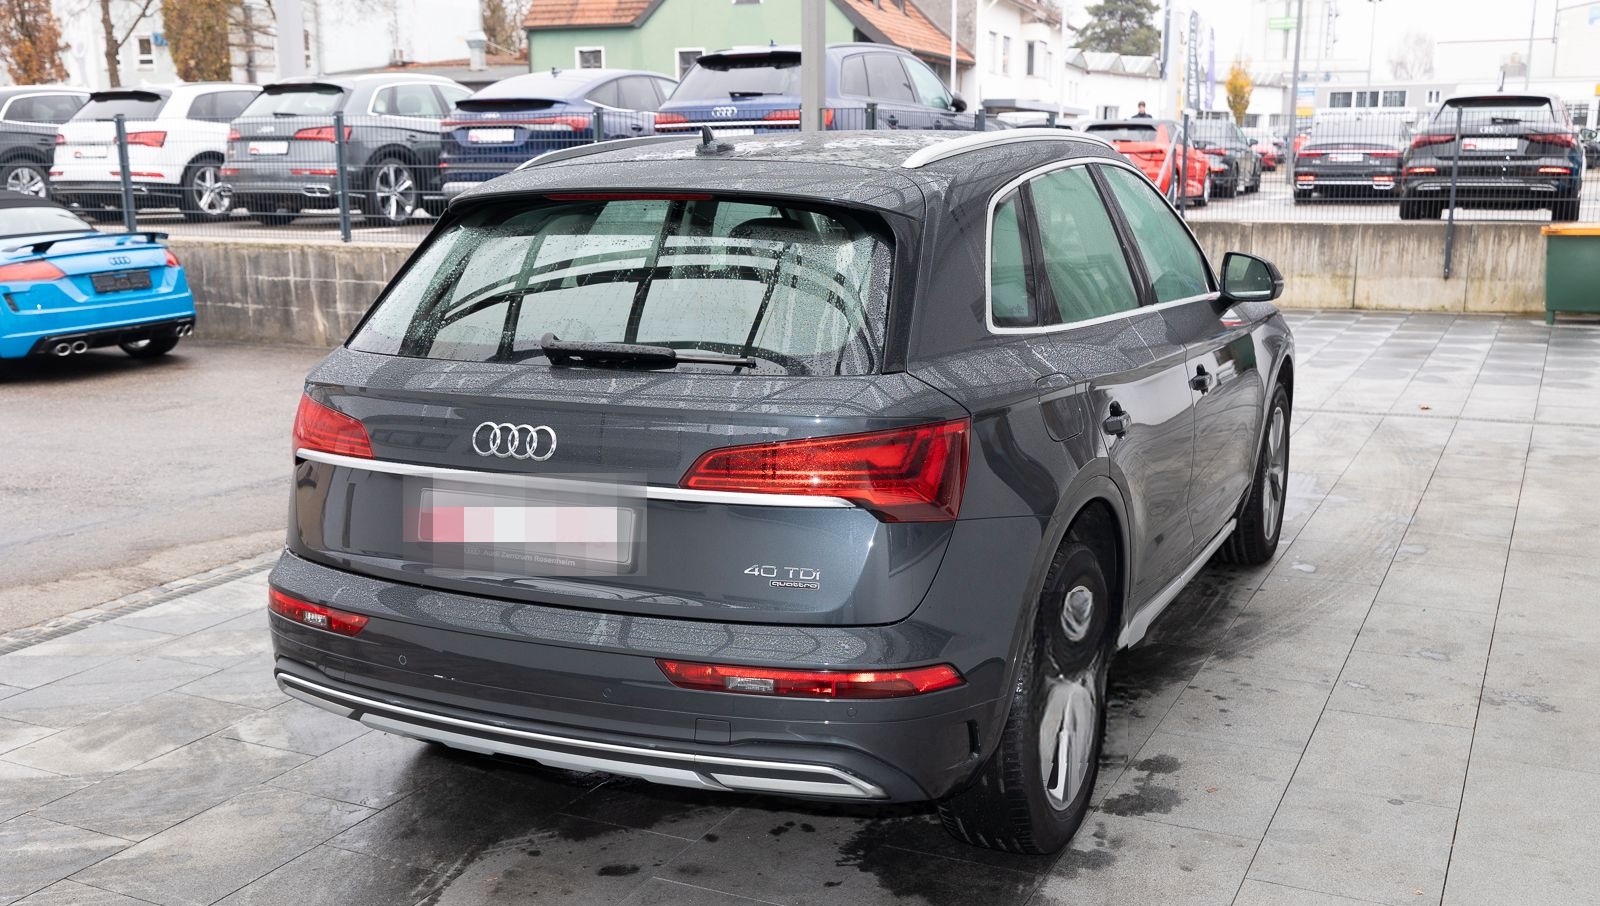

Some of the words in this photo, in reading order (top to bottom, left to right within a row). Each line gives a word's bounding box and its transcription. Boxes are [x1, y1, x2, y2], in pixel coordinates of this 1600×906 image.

[483, 549, 500, 557] Audi
[501, 552, 533, 561] Zentrum
[534, 555, 576, 566] Rosenheim
[743, 564, 777, 577] 40
[771, 580, 818, 588] quattro
